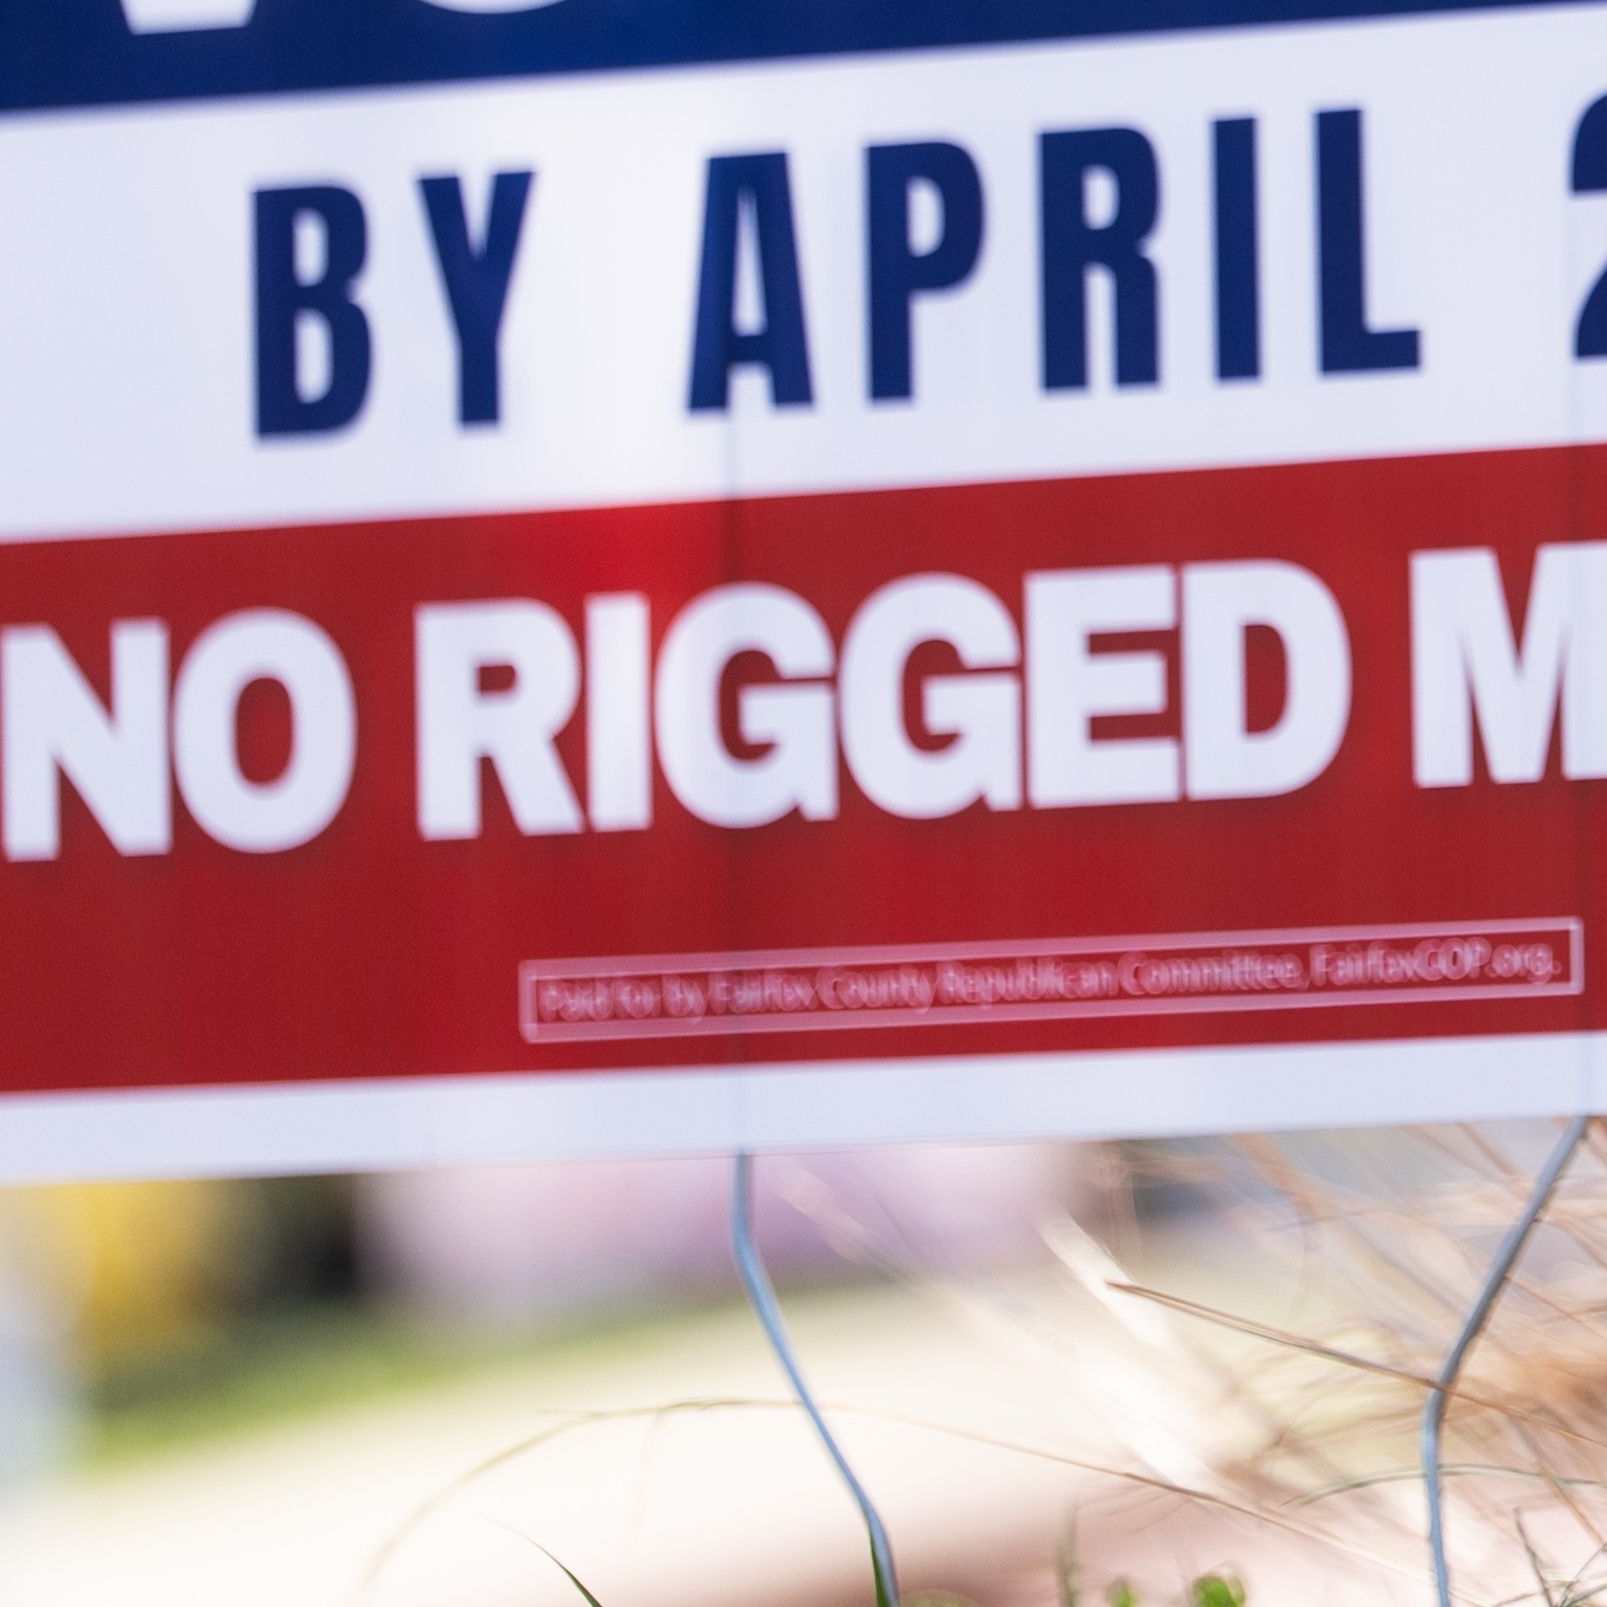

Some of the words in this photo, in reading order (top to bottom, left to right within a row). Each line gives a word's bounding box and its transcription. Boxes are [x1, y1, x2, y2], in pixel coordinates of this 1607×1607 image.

[250, 167, 535, 444] BY
[686, 106, 1424, 418] APRIL
[0, 605, 358, 864] NO
[412, 556, 1355, 842] RIGGED
[936, 955, 1118, 1010] Republican
